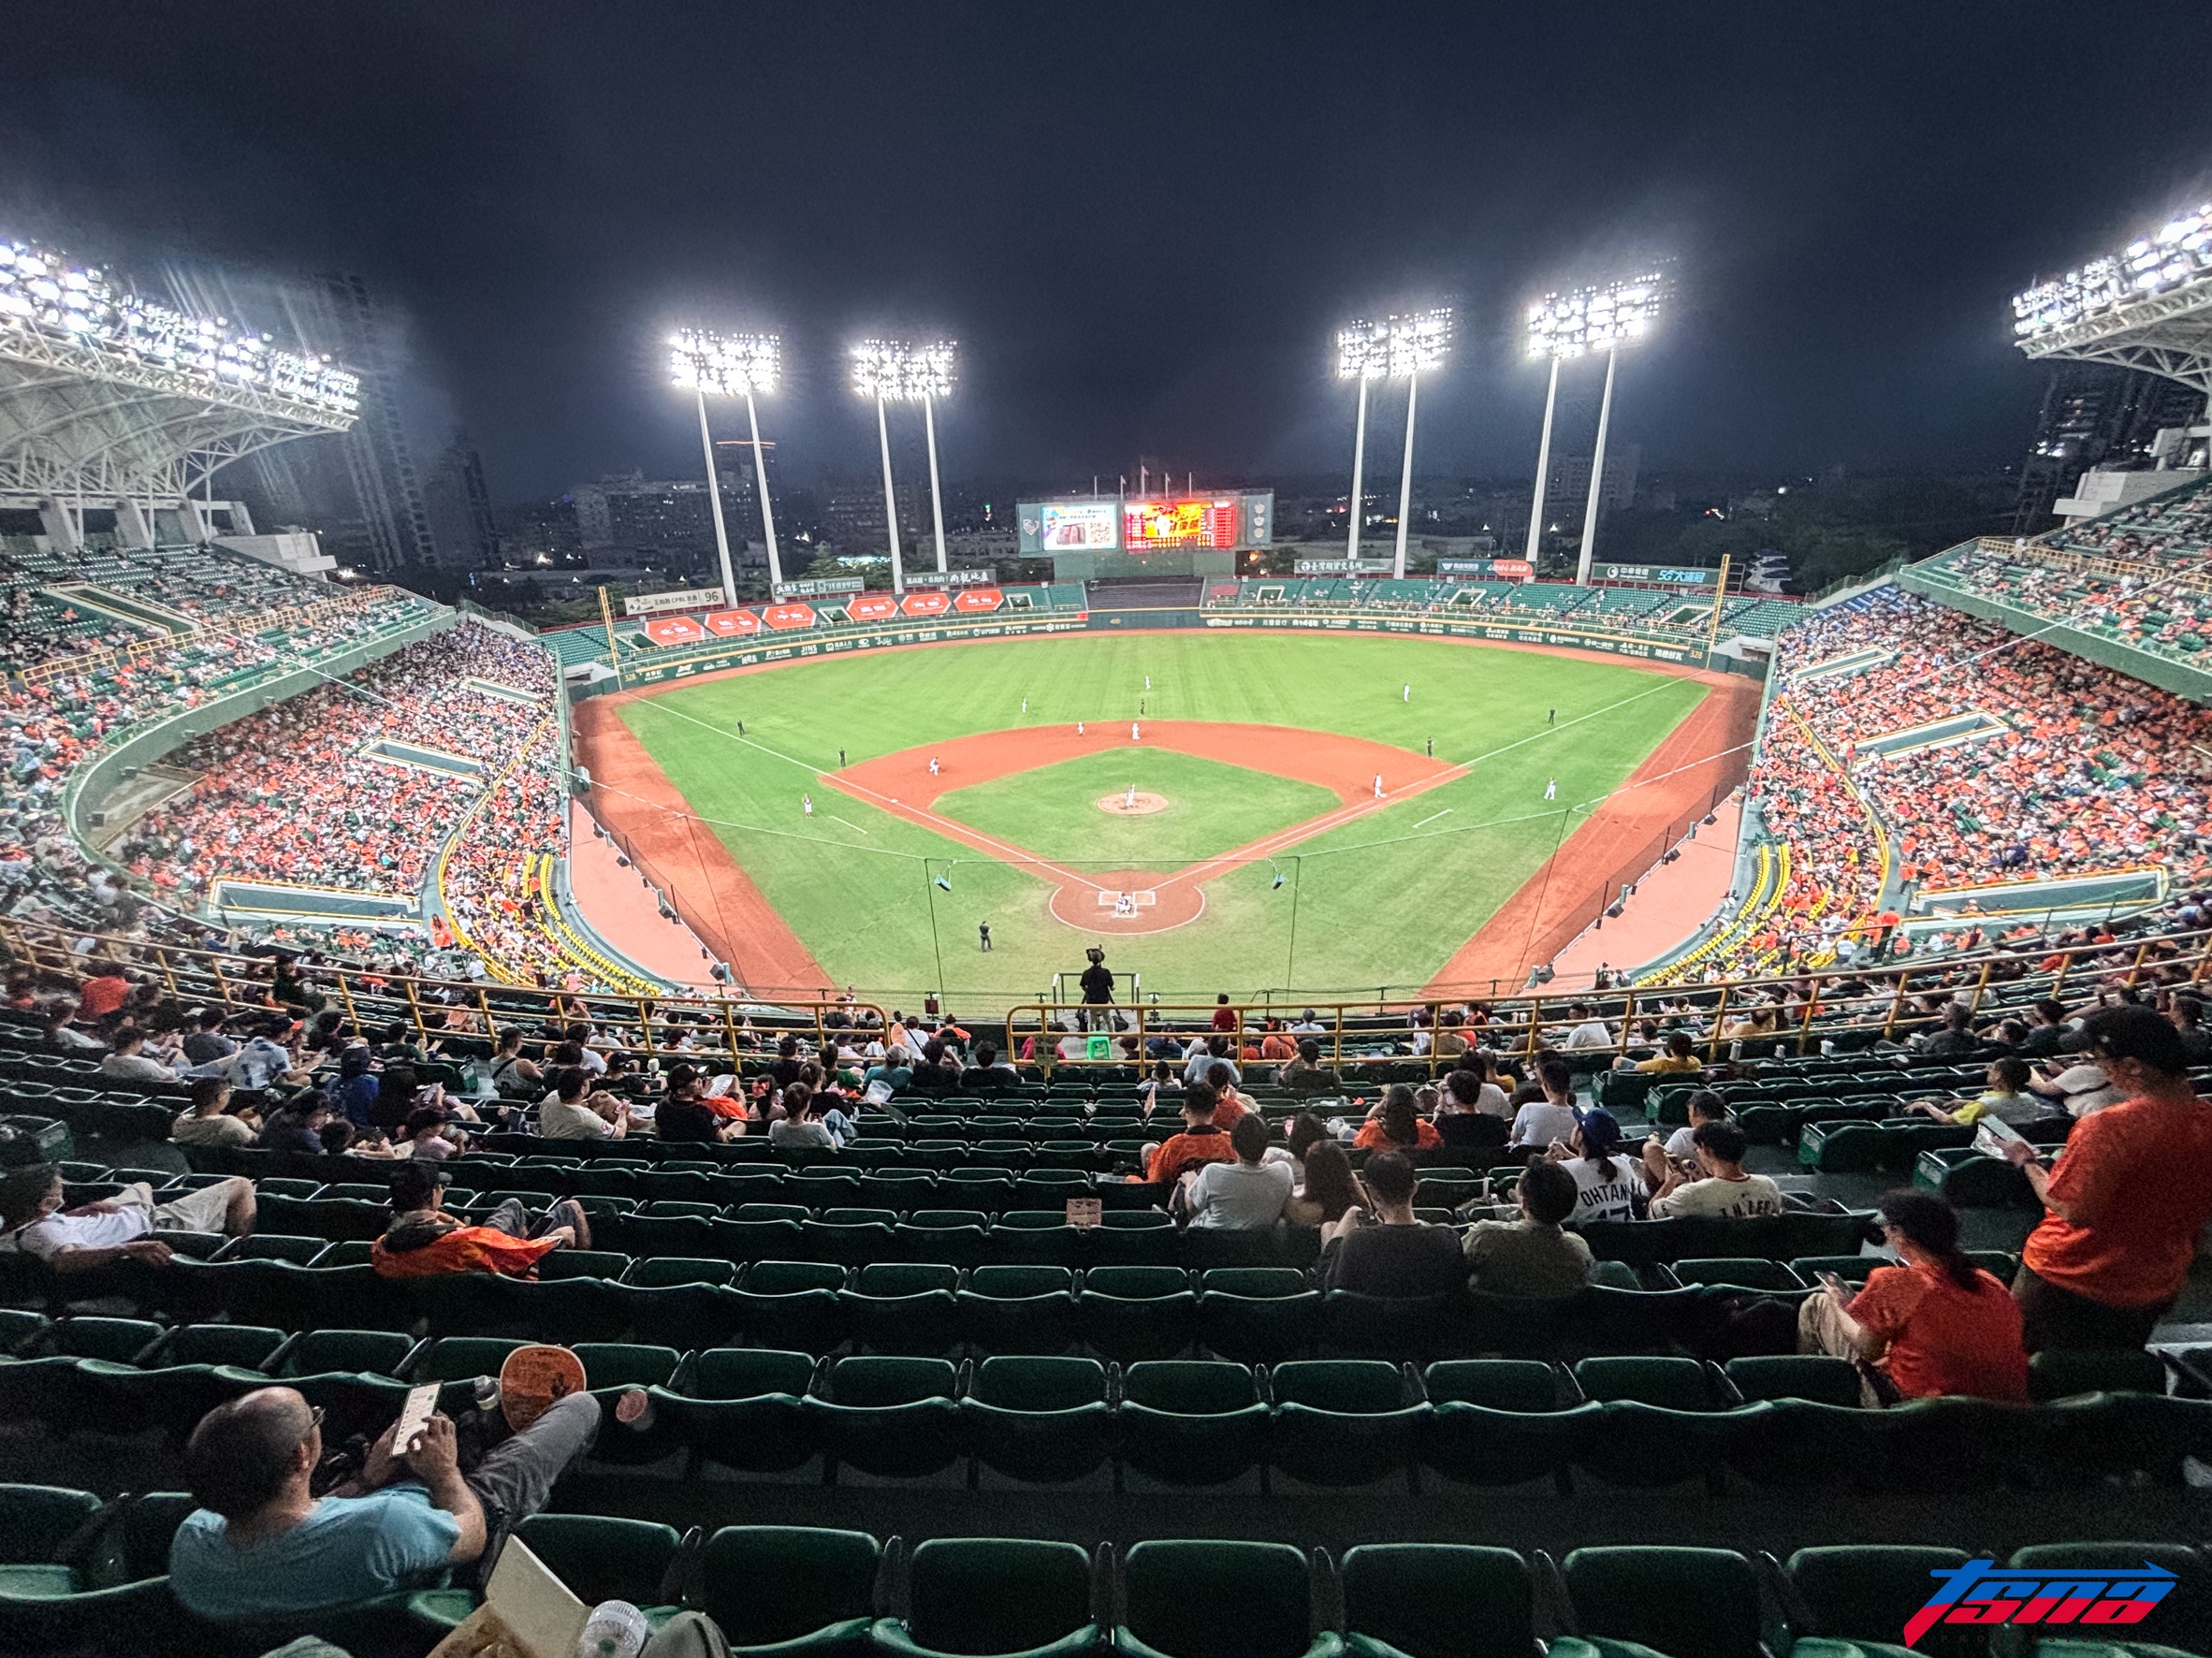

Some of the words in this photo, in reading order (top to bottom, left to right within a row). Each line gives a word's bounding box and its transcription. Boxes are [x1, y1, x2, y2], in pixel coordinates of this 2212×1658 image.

[705, 591, 719, 603] 96
[801, 644, 818, 653] JINS
[1690, 649, 1703, 659] 328
